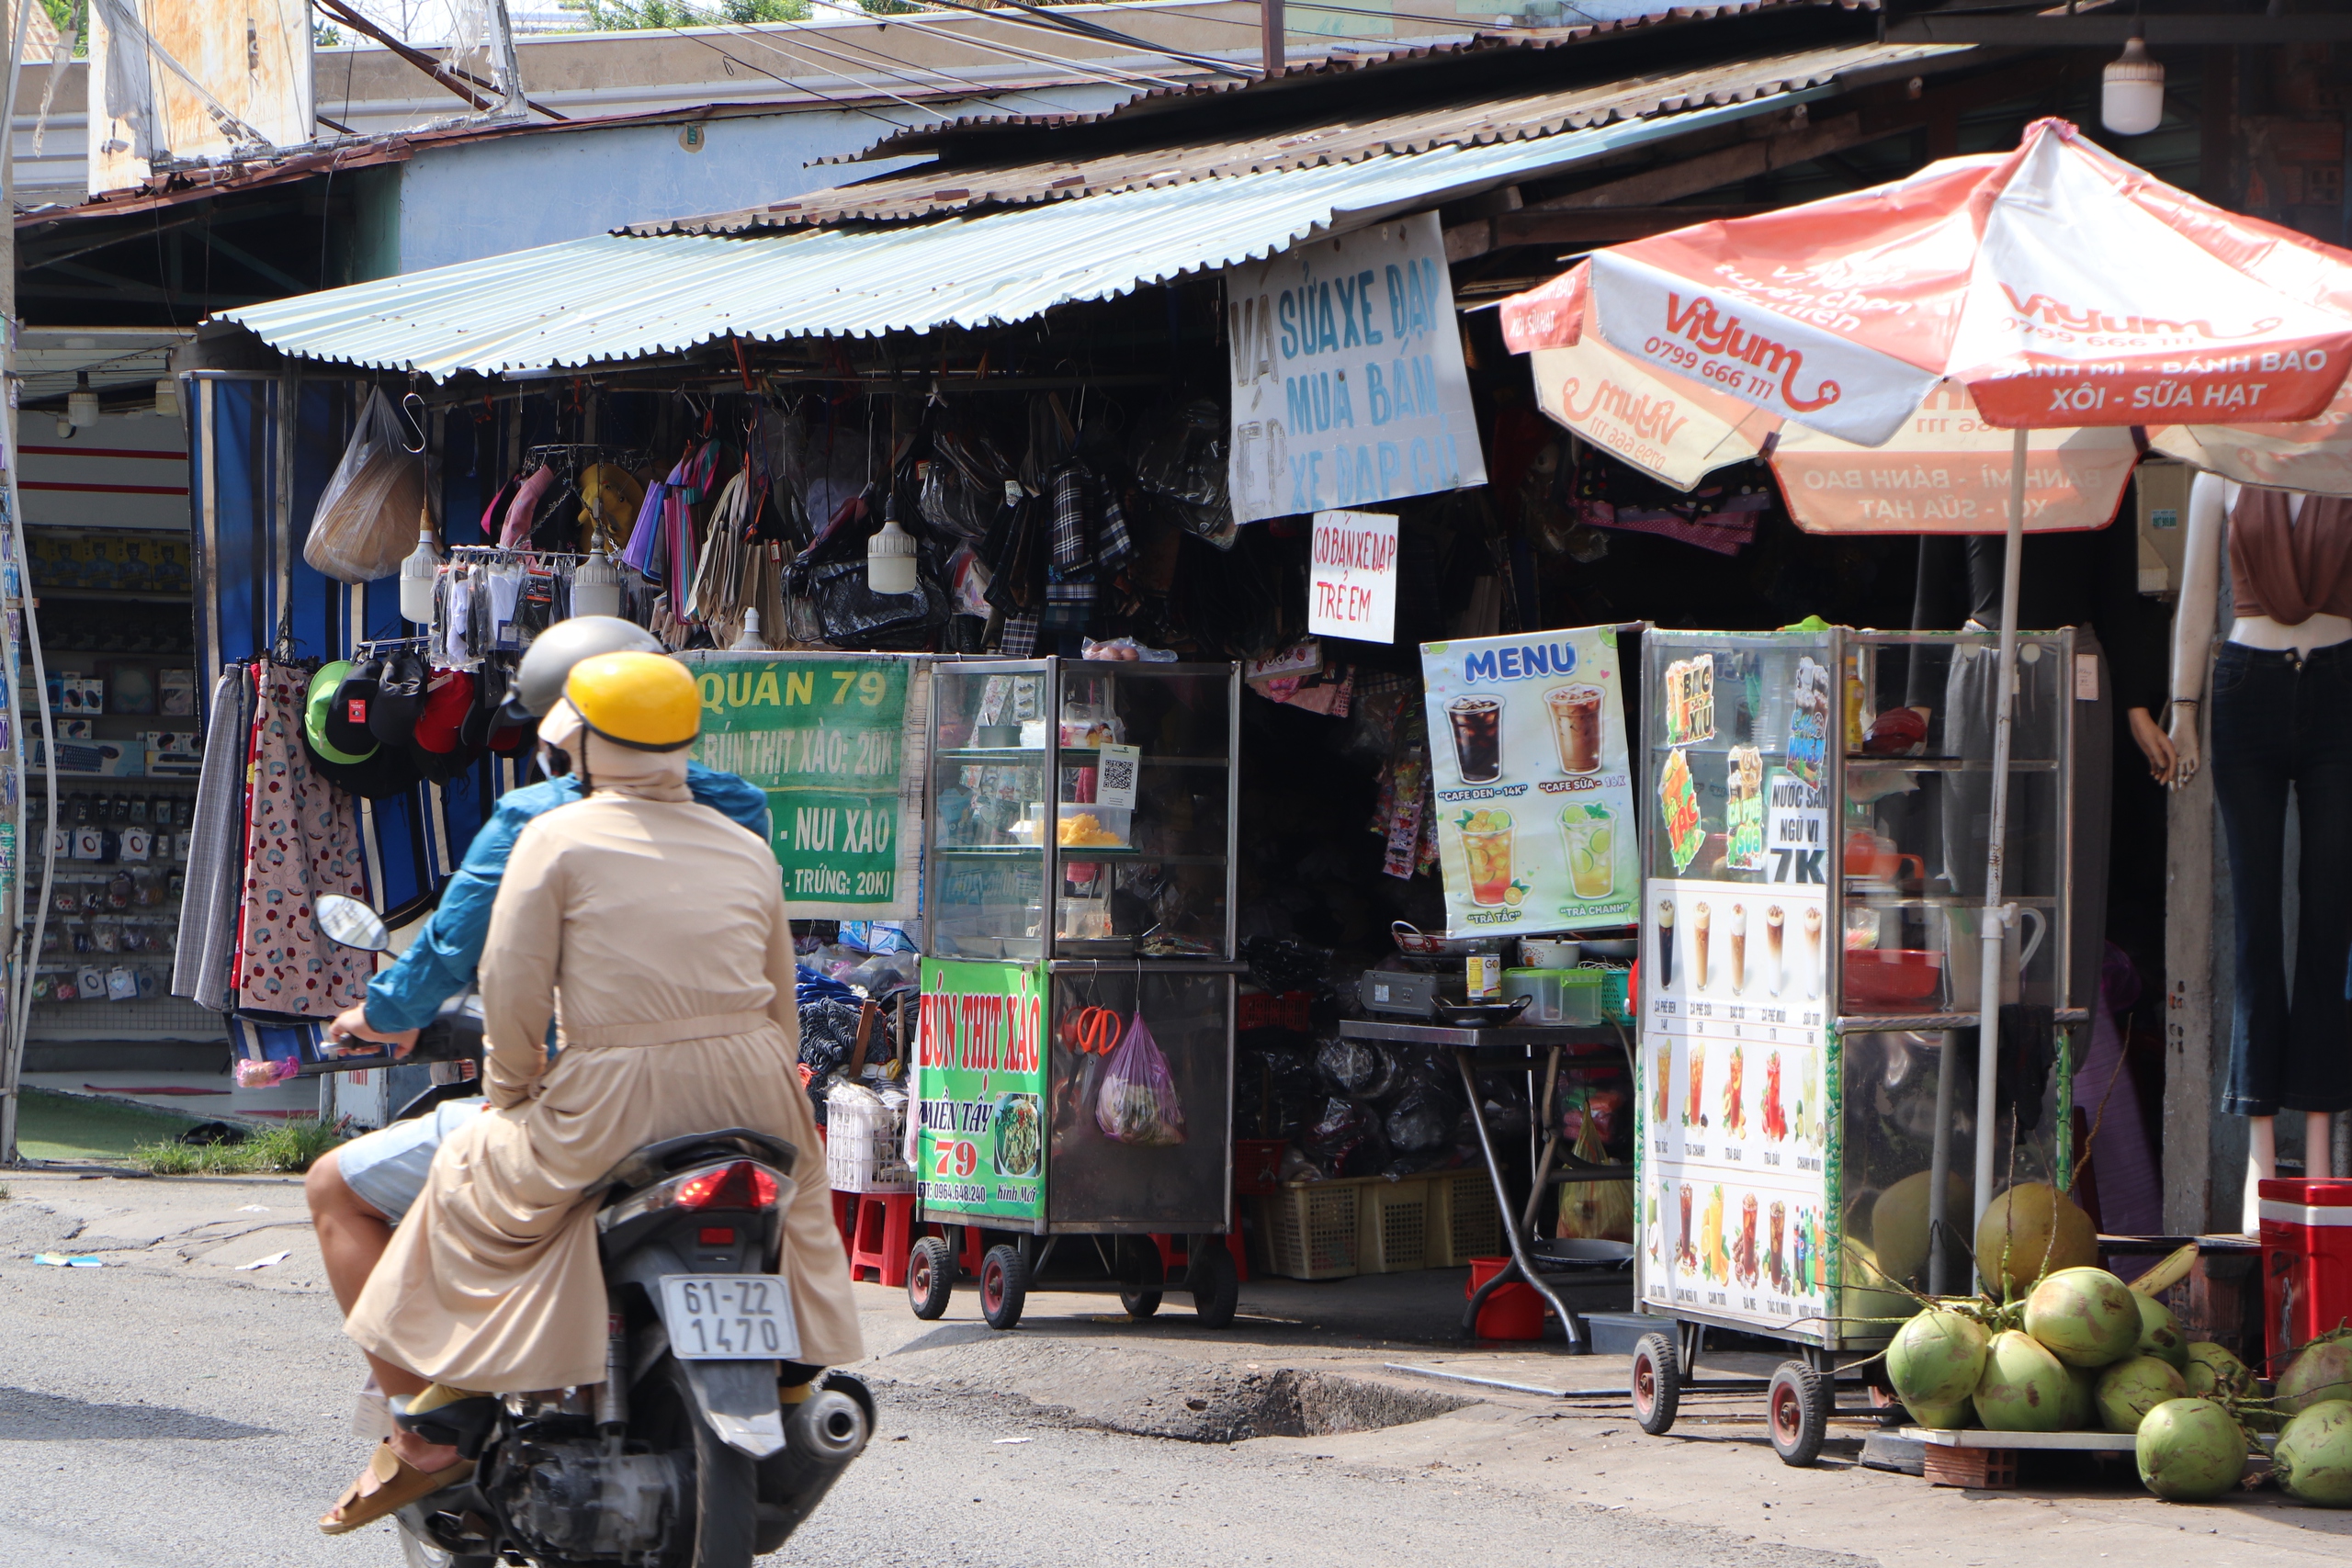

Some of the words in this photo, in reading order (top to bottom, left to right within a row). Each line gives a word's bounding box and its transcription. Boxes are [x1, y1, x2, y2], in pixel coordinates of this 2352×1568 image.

[1998, 280, 2284, 340] Viyum
[2000, 316, 2076, 344] 0799
[2086, 335, 2148, 347] 666
[2161, 337, 2194, 346] 111
[1644, 336, 1699, 370] 0799
[1702, 358, 1745, 389] 666
[1747, 376, 1775, 400] 111
[1666, 290, 1842, 413] Viyum
[2163, 356, 2251, 375] BÁNH
[2260, 349, 2328, 372] BAO
[1286, 368, 1354, 436] MUA
[1365, 339, 1439, 426] BÁN
[2049, 382, 2107, 411] XÔI
[2132, 379, 2194, 408] SỮA
[2203, 383, 2268, 412] HẠT
[1289, 449, 1327, 513] XE
[1349, 586, 1372, 623] EM
[1464, 642, 1577, 684] MENU
[697, 663, 814, 714] QUÁN
[831, 671, 886, 706] 79
[704, 721, 744, 774] BÚN
[750, 729, 796, 784] THỊT
[798, 717, 848, 773] XÀO:
[854, 732, 893, 774] 20K
[1472, 788, 1494, 799] ĐEN
[1572, 777, 1595, 791] SỮA
[1772, 781, 1804, 808] NƯỚC
[795, 807, 835, 852] NUI
[842, 798, 889, 853] XÀO
[1781, 816, 1804, 841] NGŨ
[1807, 819, 1819, 847] VỊ
[795, 863, 851, 896] TRỨNG:
[856, 871, 890, 897] 20K)
[1770, 848, 1826, 885] 7K
[920, 970, 957, 1068] BÚN
[961, 994, 1001, 1092] THỊT
[1003, 972, 1041, 1074] XÀO
[919, 1088, 959, 1132] MIỀN
[962, 1095, 993, 1134] TÂY
[934, 1139, 978, 1179] 79
[934, 1183, 986, 1203] 0964.648.240
[684, 1282, 773, 1315] 61-Z2
[691, 1318, 779, 1353] 1470
